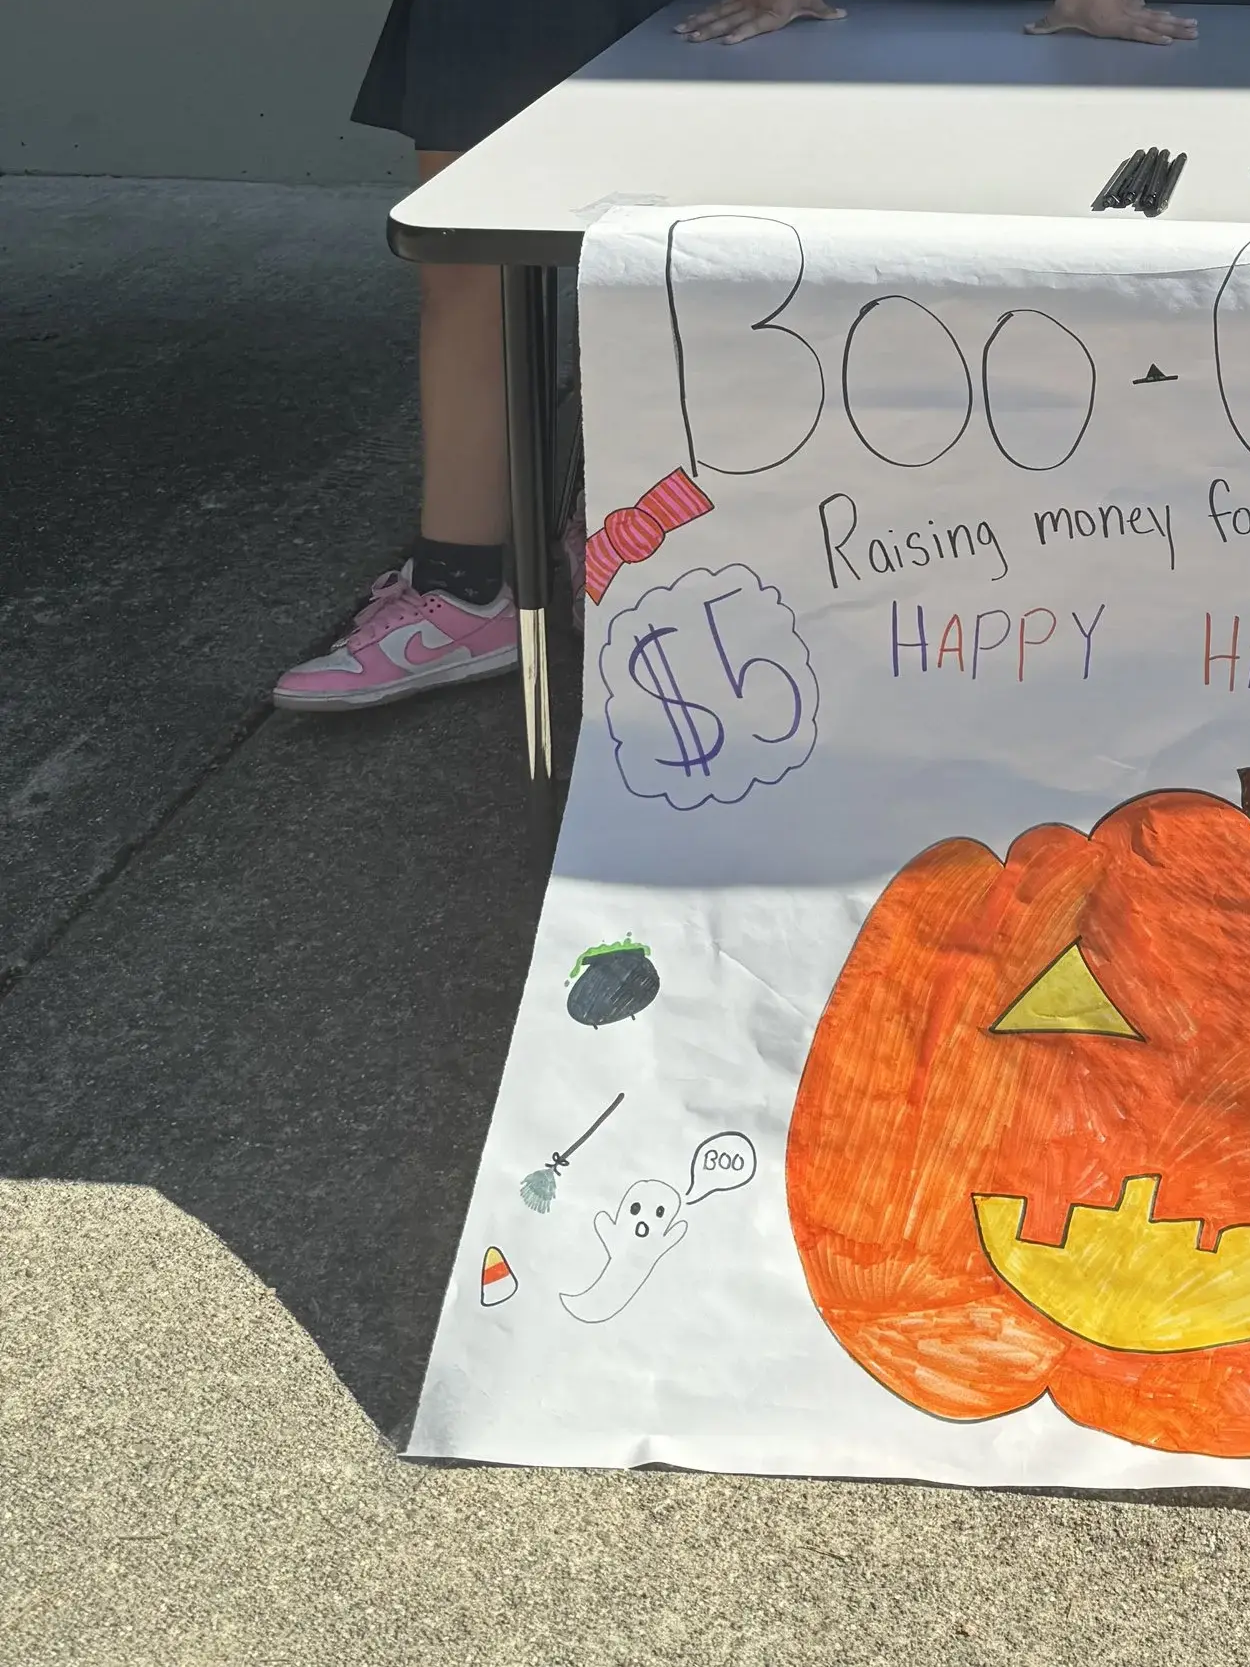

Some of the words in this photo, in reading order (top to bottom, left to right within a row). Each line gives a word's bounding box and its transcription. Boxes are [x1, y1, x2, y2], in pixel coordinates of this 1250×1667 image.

[819, 493, 1009, 588] Raising
[1033, 504, 1175, 570] money
[628, 587, 801, 777] $5
[892, 600, 1105, 682] HAPPY
[703, 1149, 745, 1172] BOO
